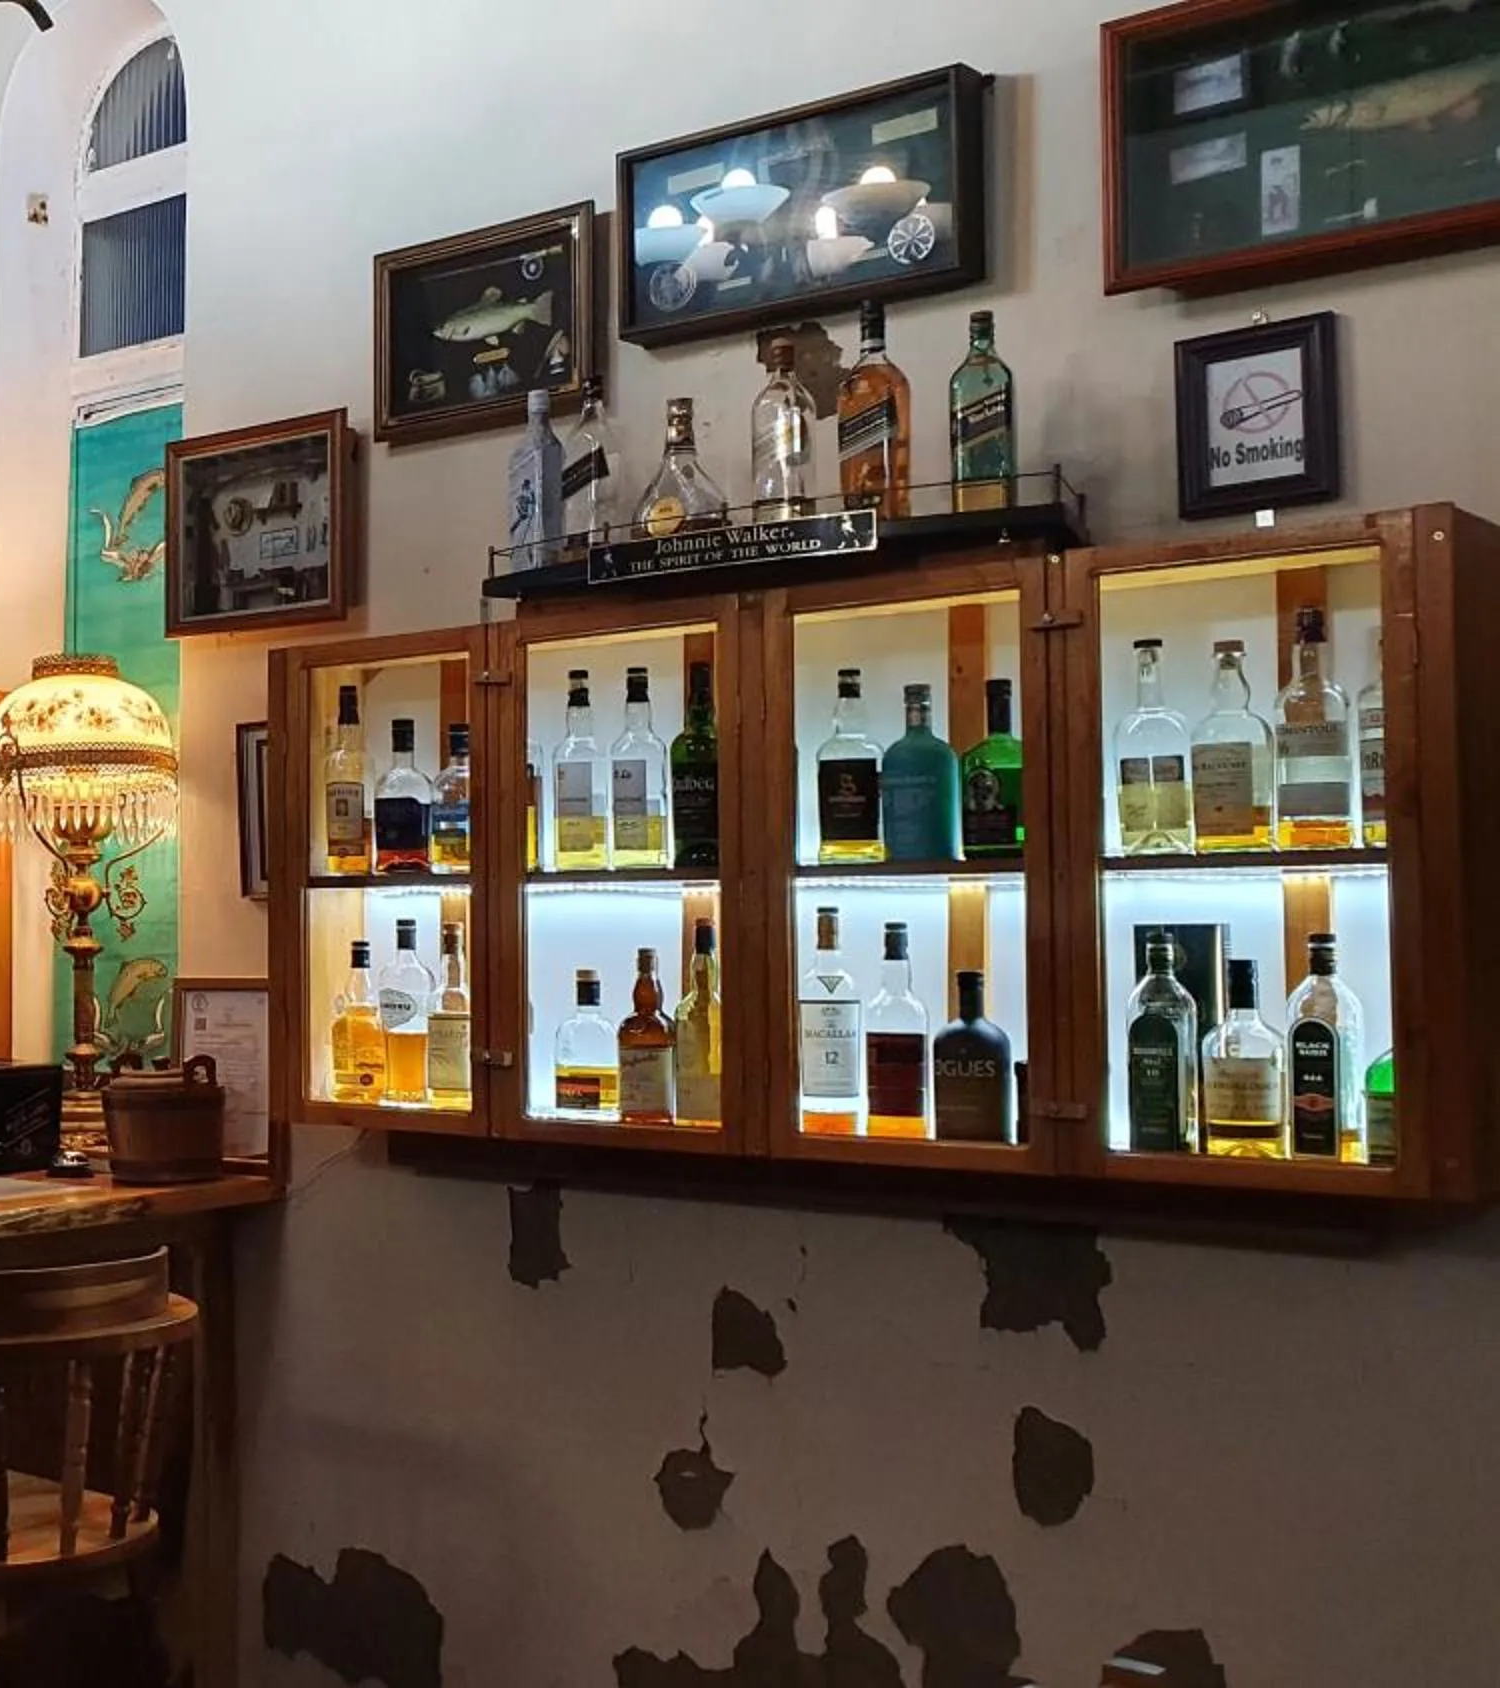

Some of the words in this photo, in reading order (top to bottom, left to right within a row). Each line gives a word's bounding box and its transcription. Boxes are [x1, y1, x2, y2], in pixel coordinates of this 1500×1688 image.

[1210, 446, 1231, 469] No
[1235, 435, 1304, 465] Smoking
[628, 560, 654, 573] THE
[658, 553, 701, 570] SPIRIT
[704, 550, 723, 562] OF
[729, 545, 759, 560] THE
[766, 539, 822, 555] WORLD
[655, 532, 722, 555] Johnnie
